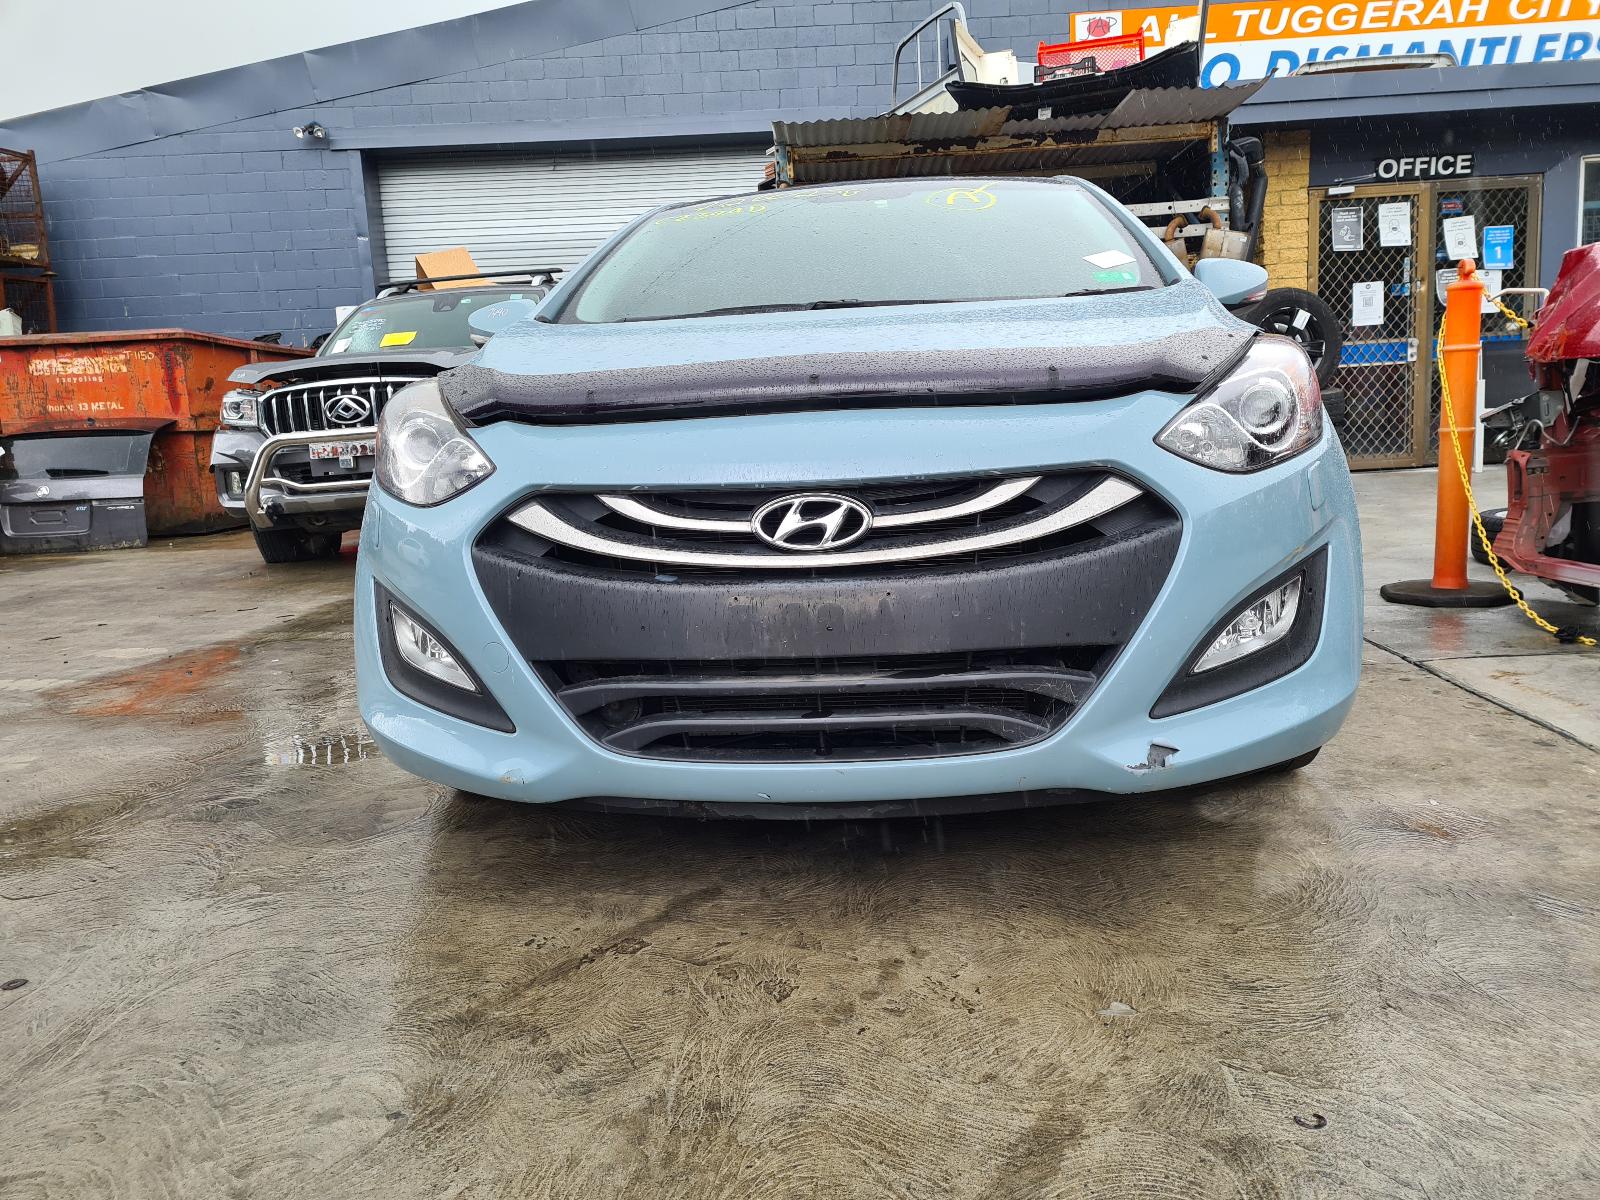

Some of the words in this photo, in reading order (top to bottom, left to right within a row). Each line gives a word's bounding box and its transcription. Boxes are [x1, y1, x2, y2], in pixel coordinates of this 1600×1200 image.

[1232, 0, 1490, 38] TUGGERAH
[1378, 154, 1472, 179] OFFICE
[78, 402, 89, 411] 13
[91, 401, 124, 412] METAL
